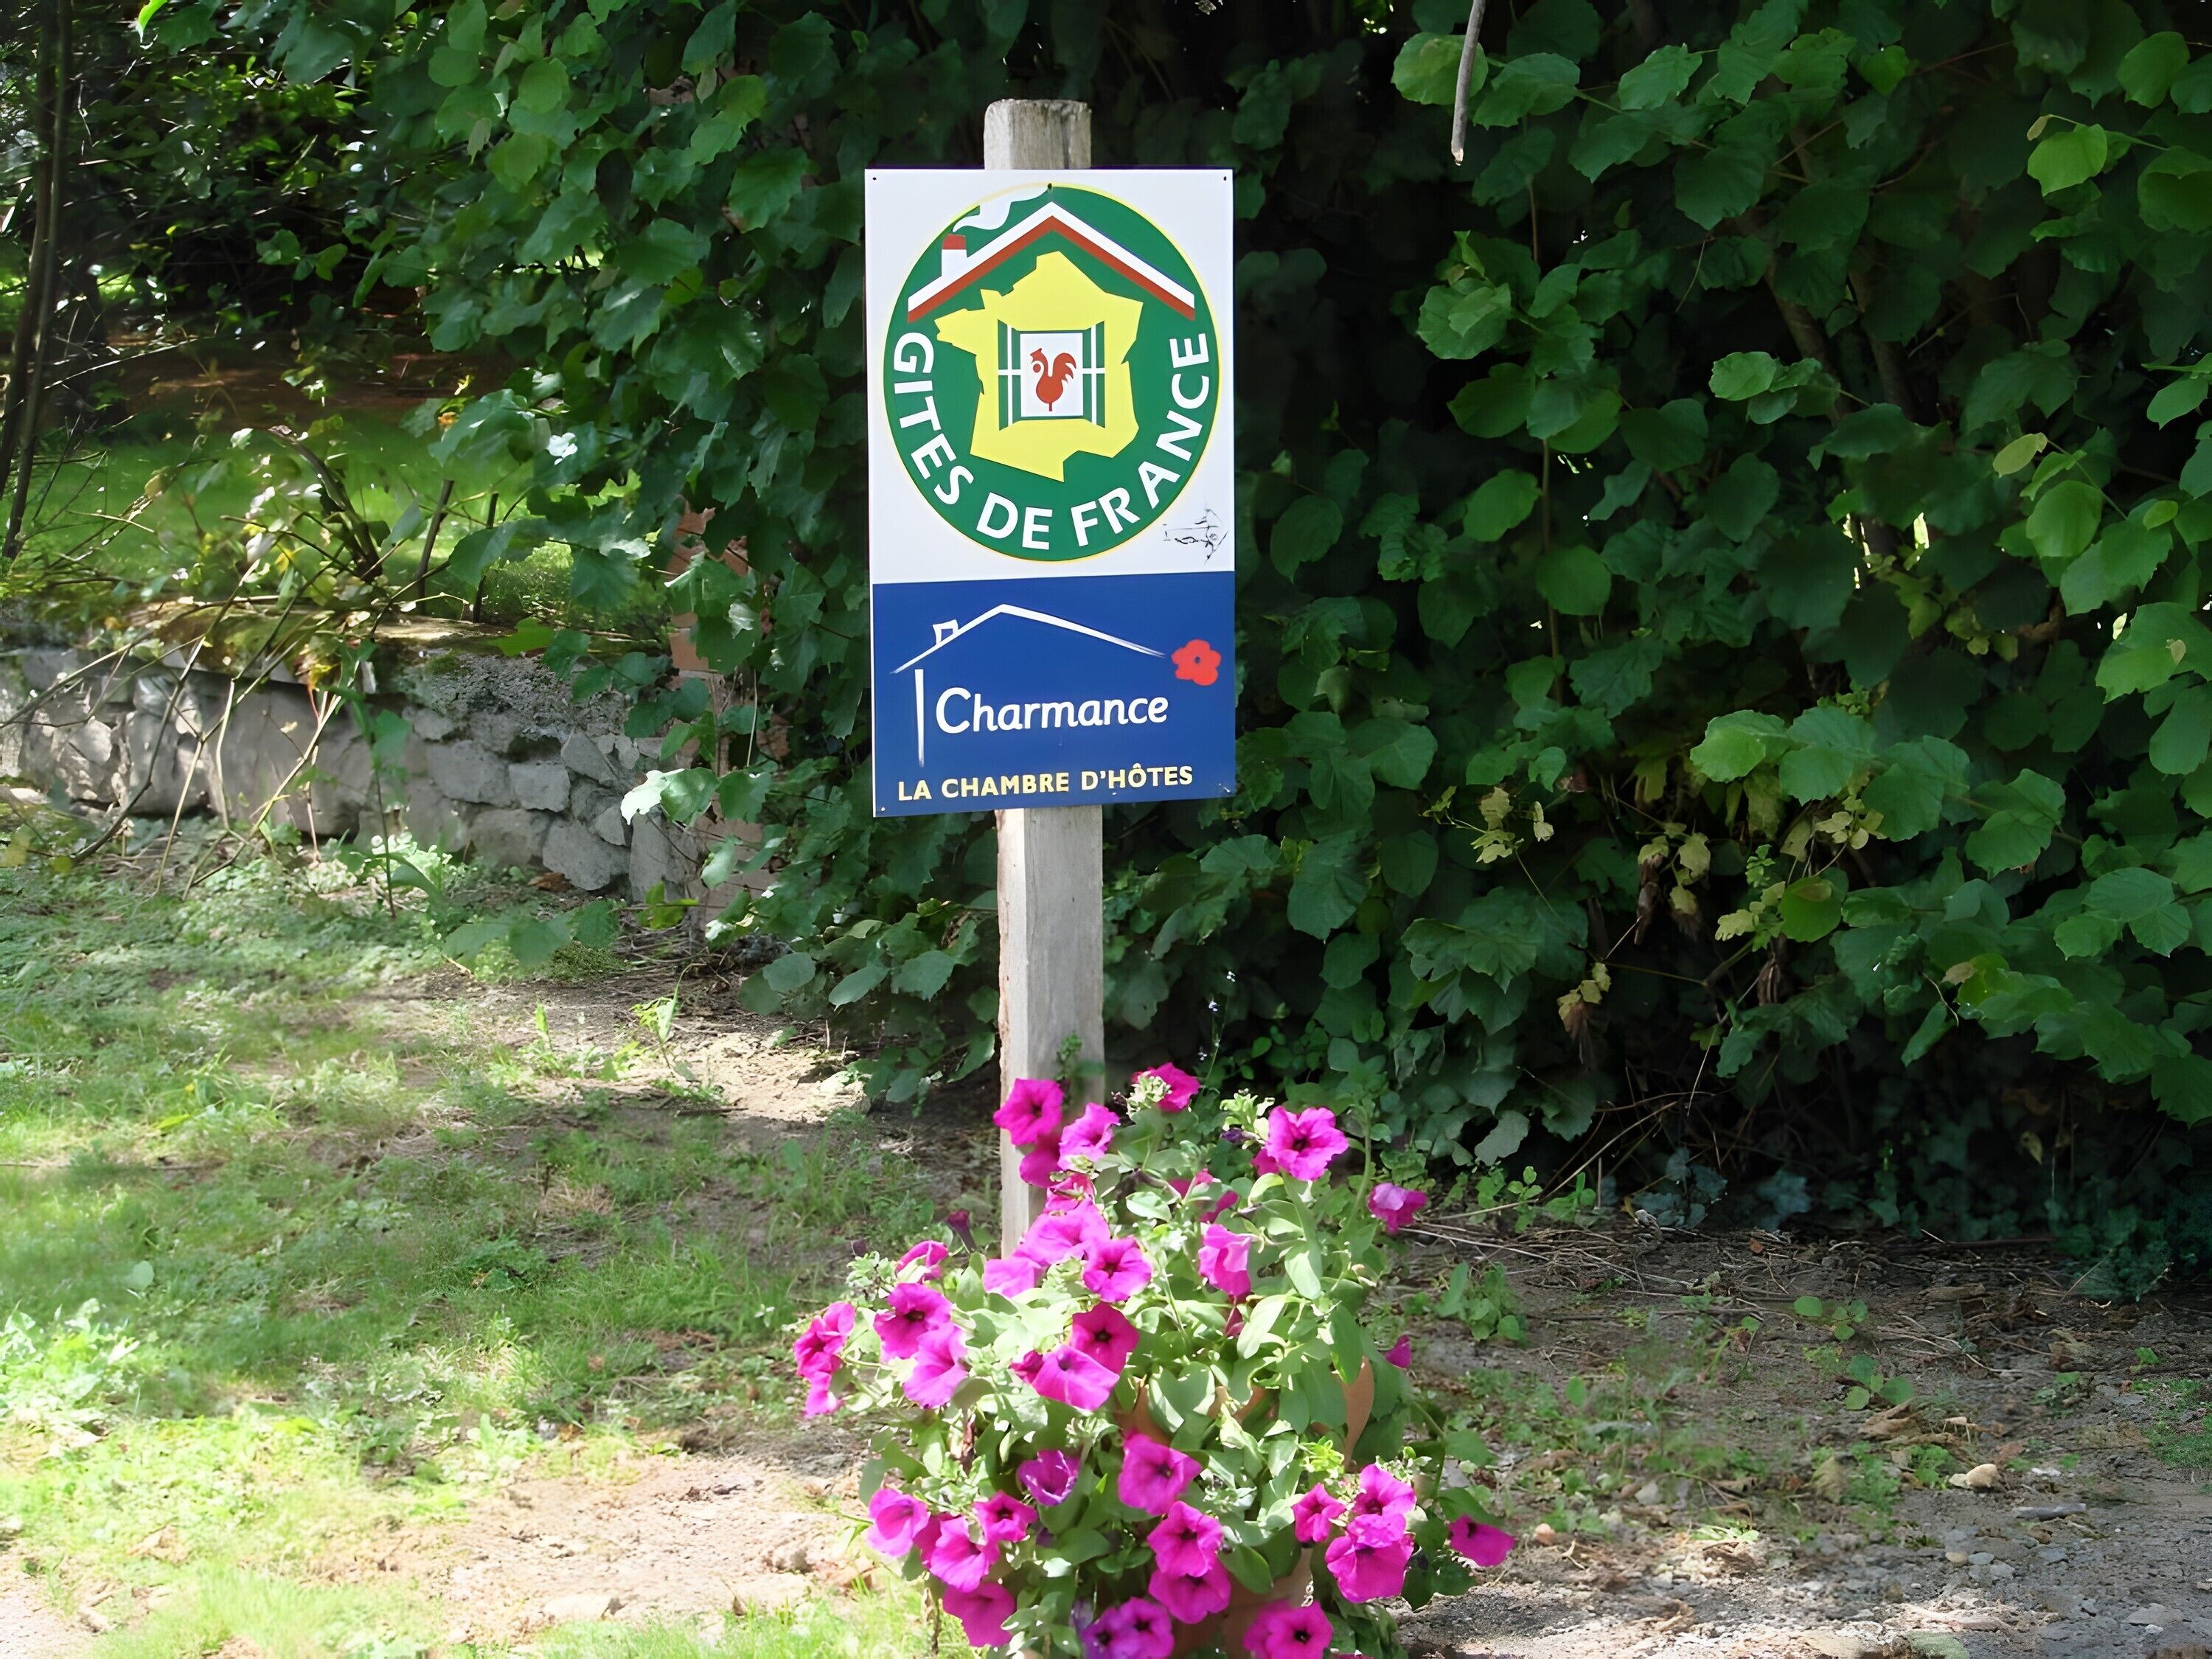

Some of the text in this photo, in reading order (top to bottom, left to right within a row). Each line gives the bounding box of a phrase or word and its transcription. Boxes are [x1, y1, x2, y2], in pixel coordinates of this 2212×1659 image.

[893, 332, 1210, 551] GITES DE FRANCE
[935, 686, 1169, 734] Charmance
[897, 762, 1194, 801] LA CHAMBRE D'HÔTES
